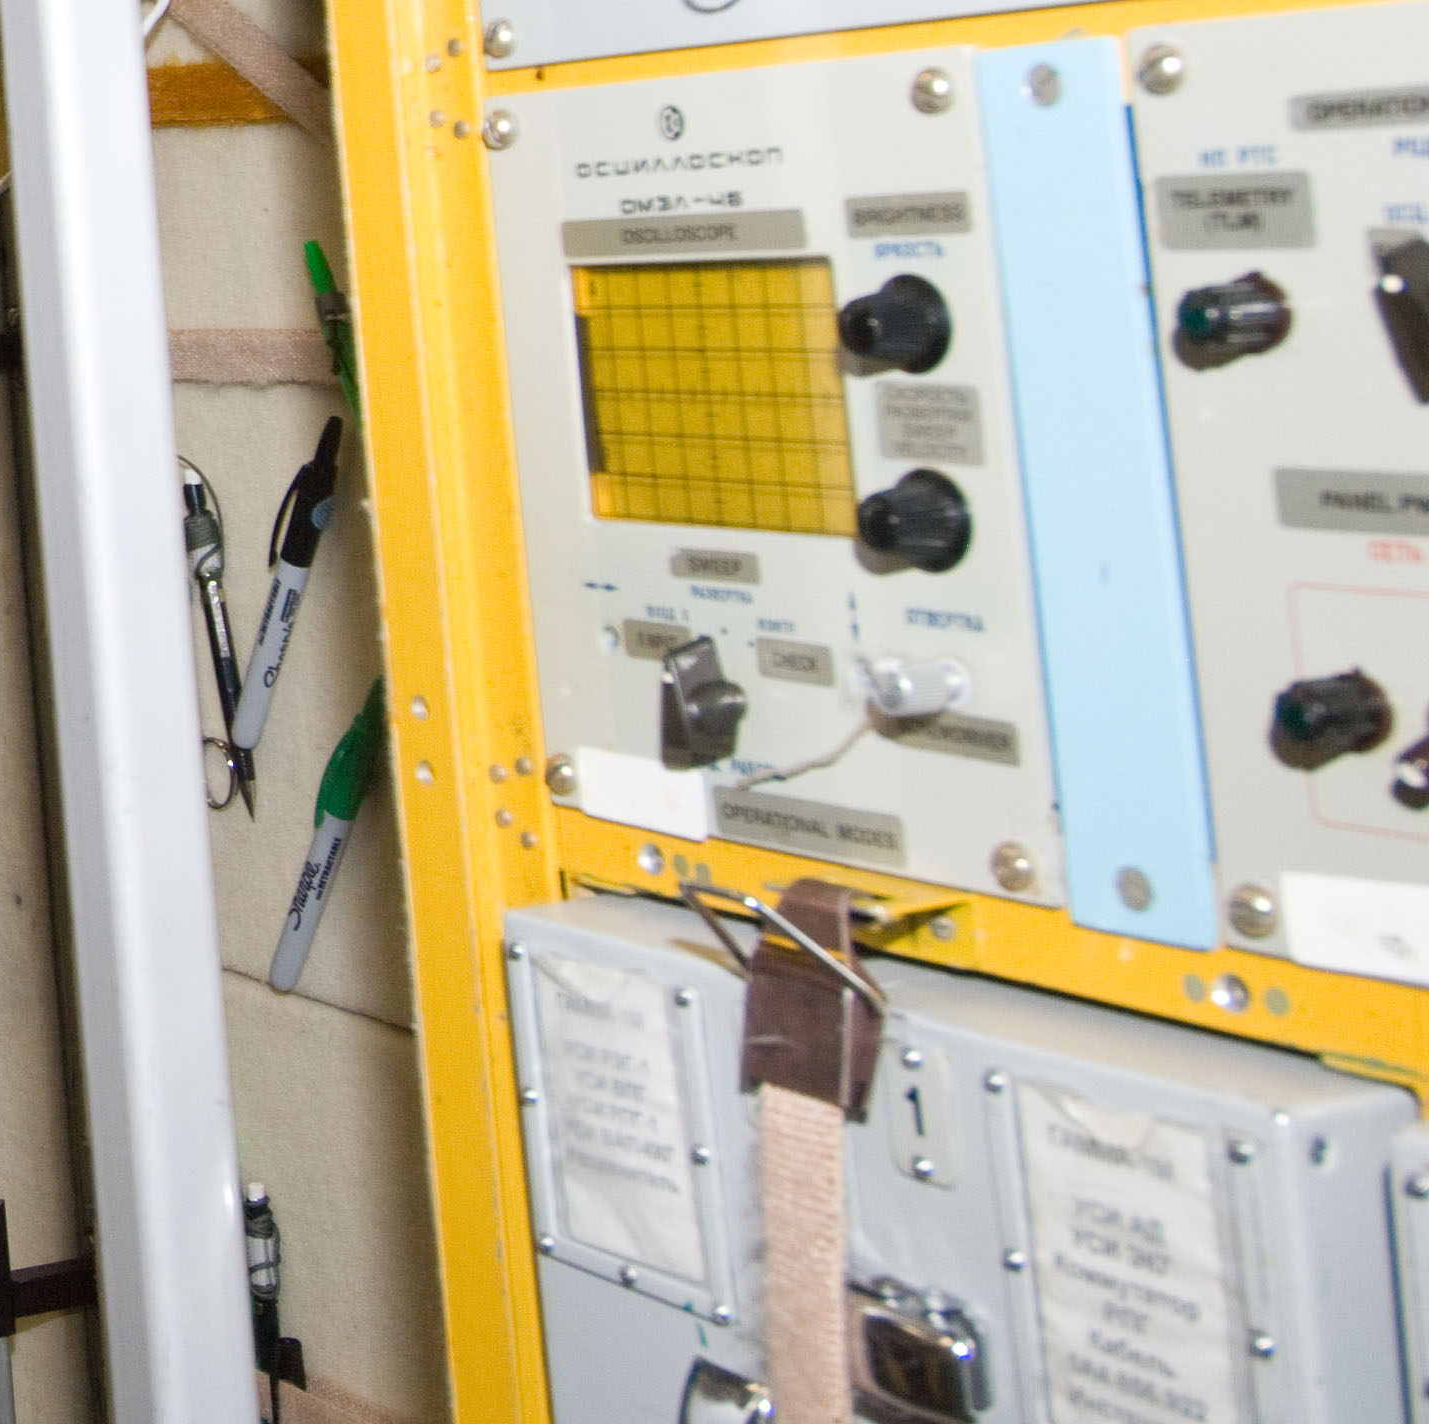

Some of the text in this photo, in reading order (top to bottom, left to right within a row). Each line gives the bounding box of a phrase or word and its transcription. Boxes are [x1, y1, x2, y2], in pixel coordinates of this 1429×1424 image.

[620, 222, 738, 245] OSCILLOSCOPE
[721, 802, 900, 852] OPERATIONAL MODES
[905, 1086, 926, 1139] 1
